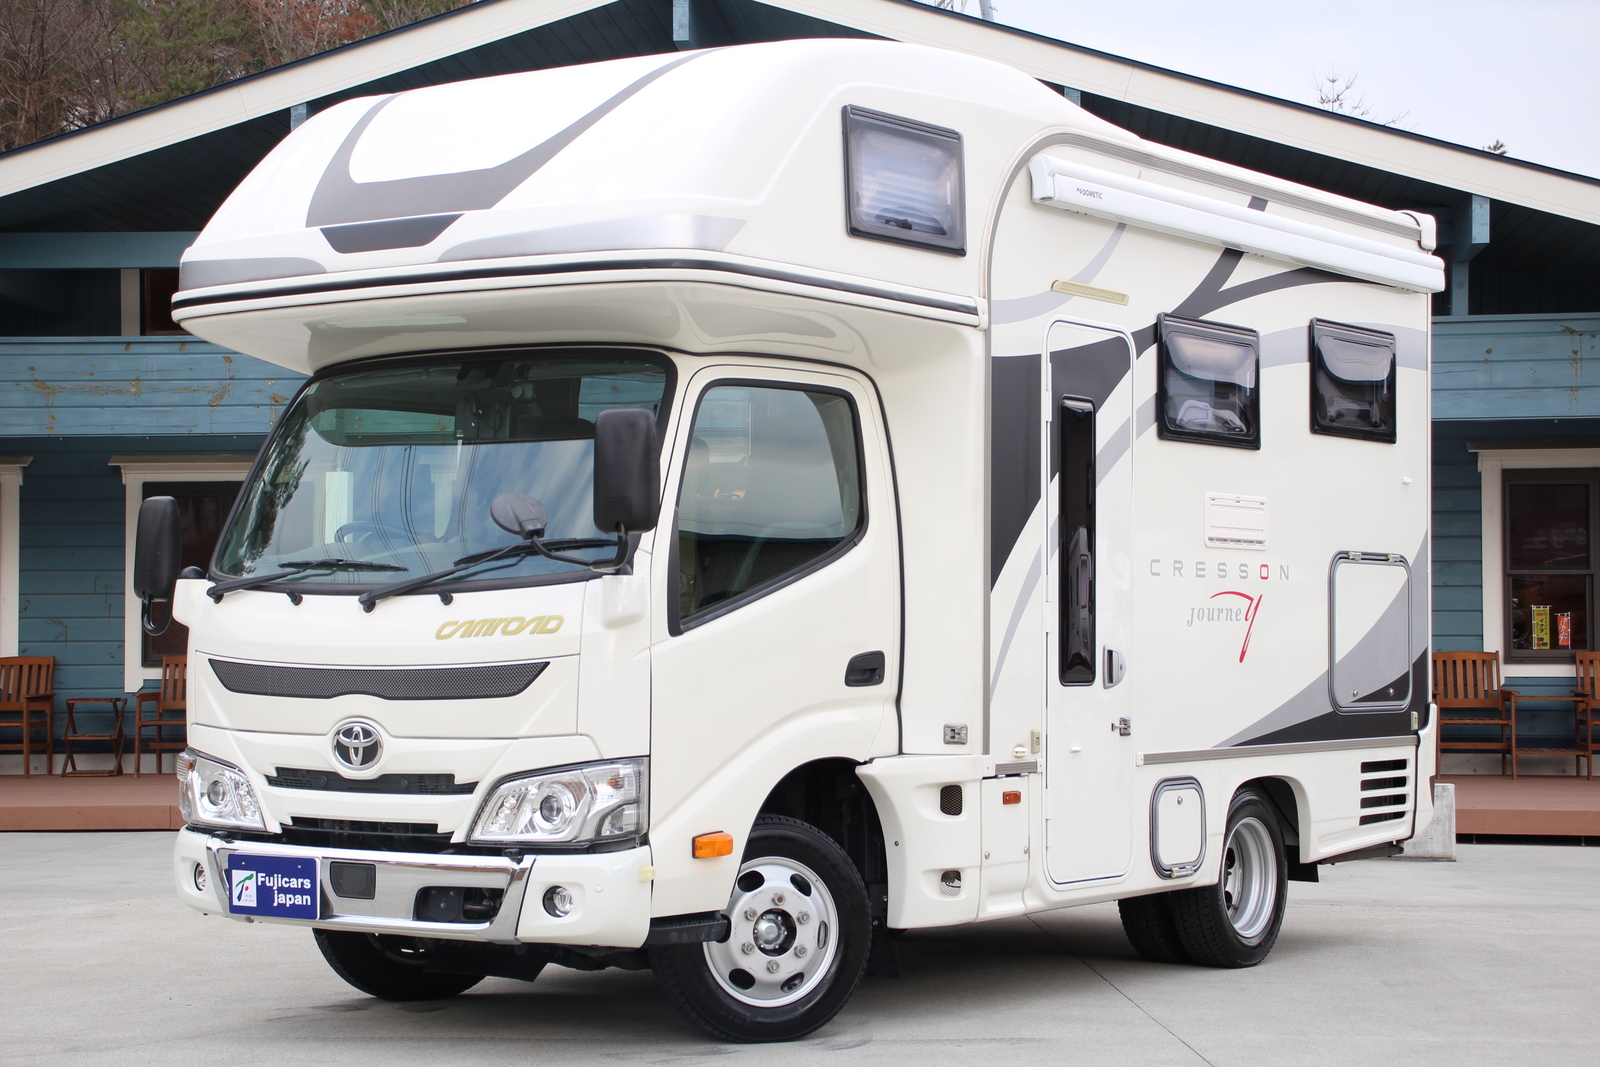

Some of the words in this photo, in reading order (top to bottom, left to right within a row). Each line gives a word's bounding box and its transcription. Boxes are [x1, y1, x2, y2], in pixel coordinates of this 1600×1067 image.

[1082, 188, 1103, 200] DOMETIC
[1150, 558, 1290, 581] CRESSON
[257, 872, 312, 890] Fujicars
[273, 890, 311, 907] japan
